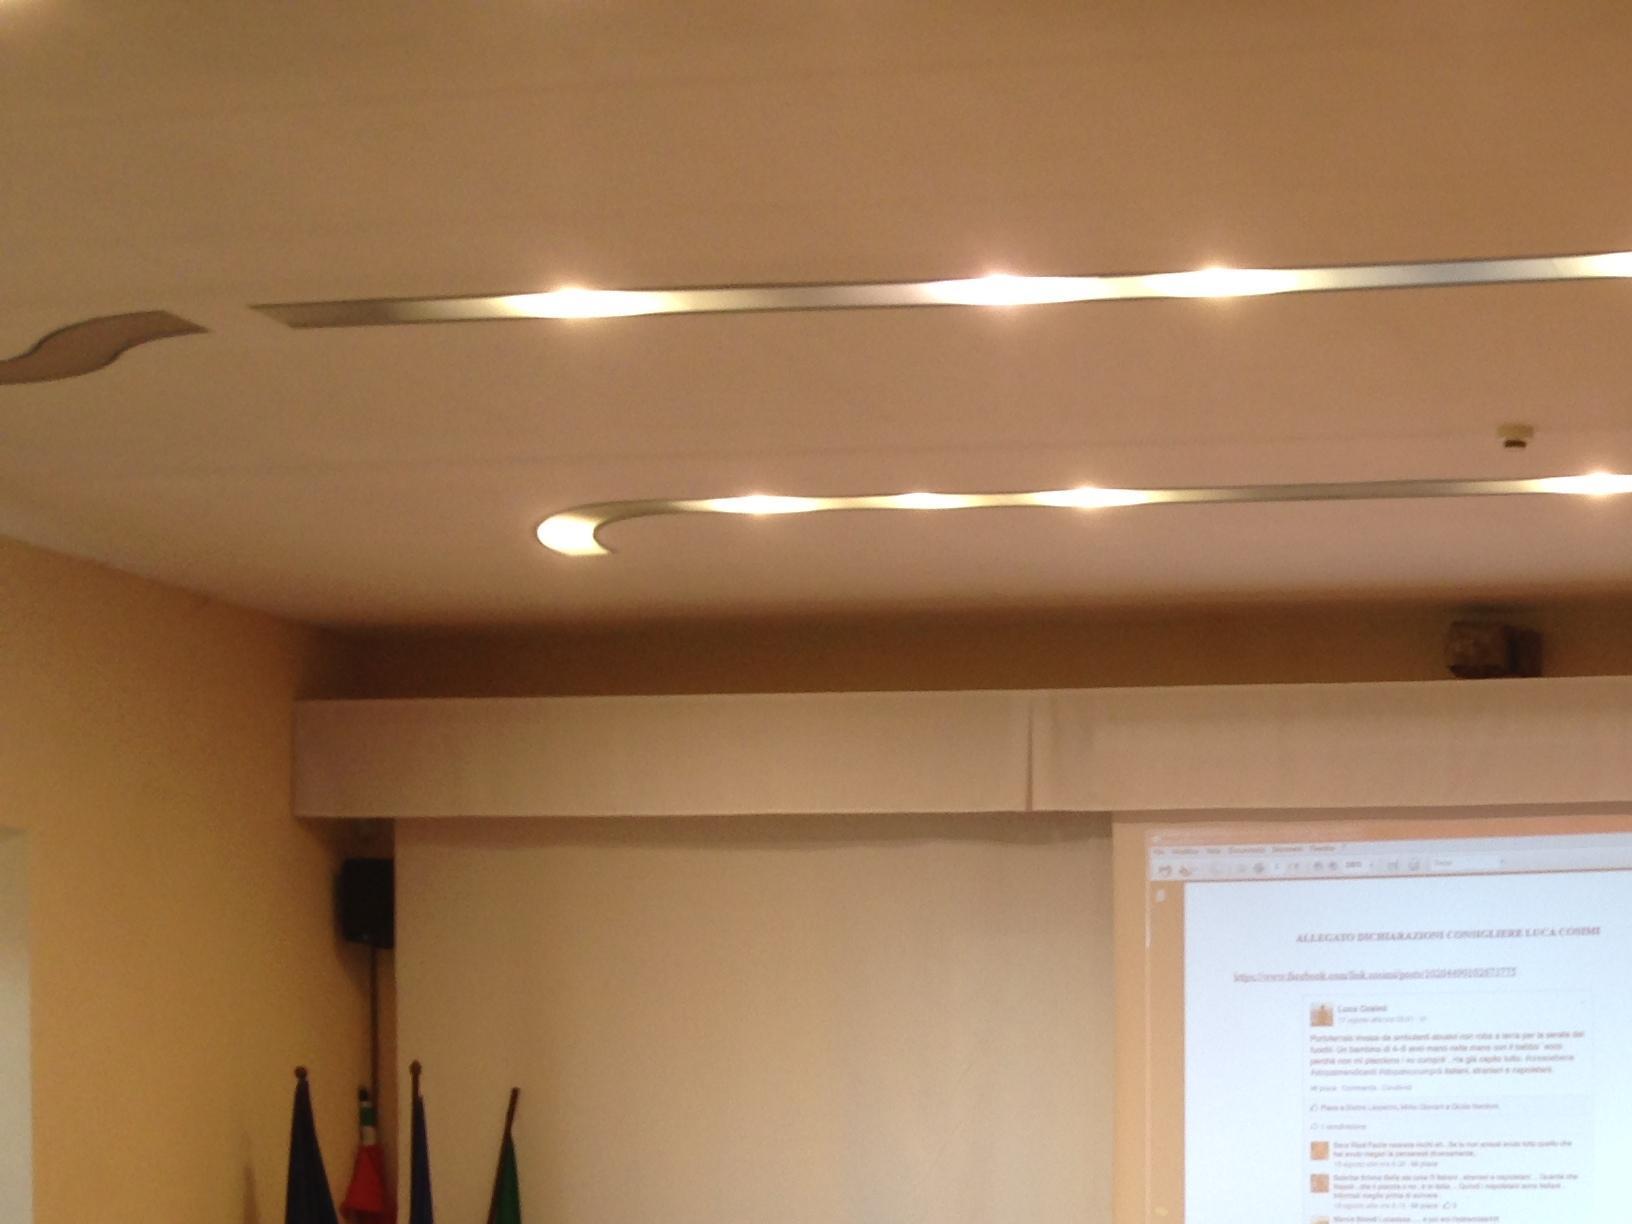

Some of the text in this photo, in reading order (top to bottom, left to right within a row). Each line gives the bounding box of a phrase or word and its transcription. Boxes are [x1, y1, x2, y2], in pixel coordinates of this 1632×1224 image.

[1296, 926, 1601, 943] ALLEGATO DICHIARAZIONI CONSIGLIERE LUCA COSIMI
